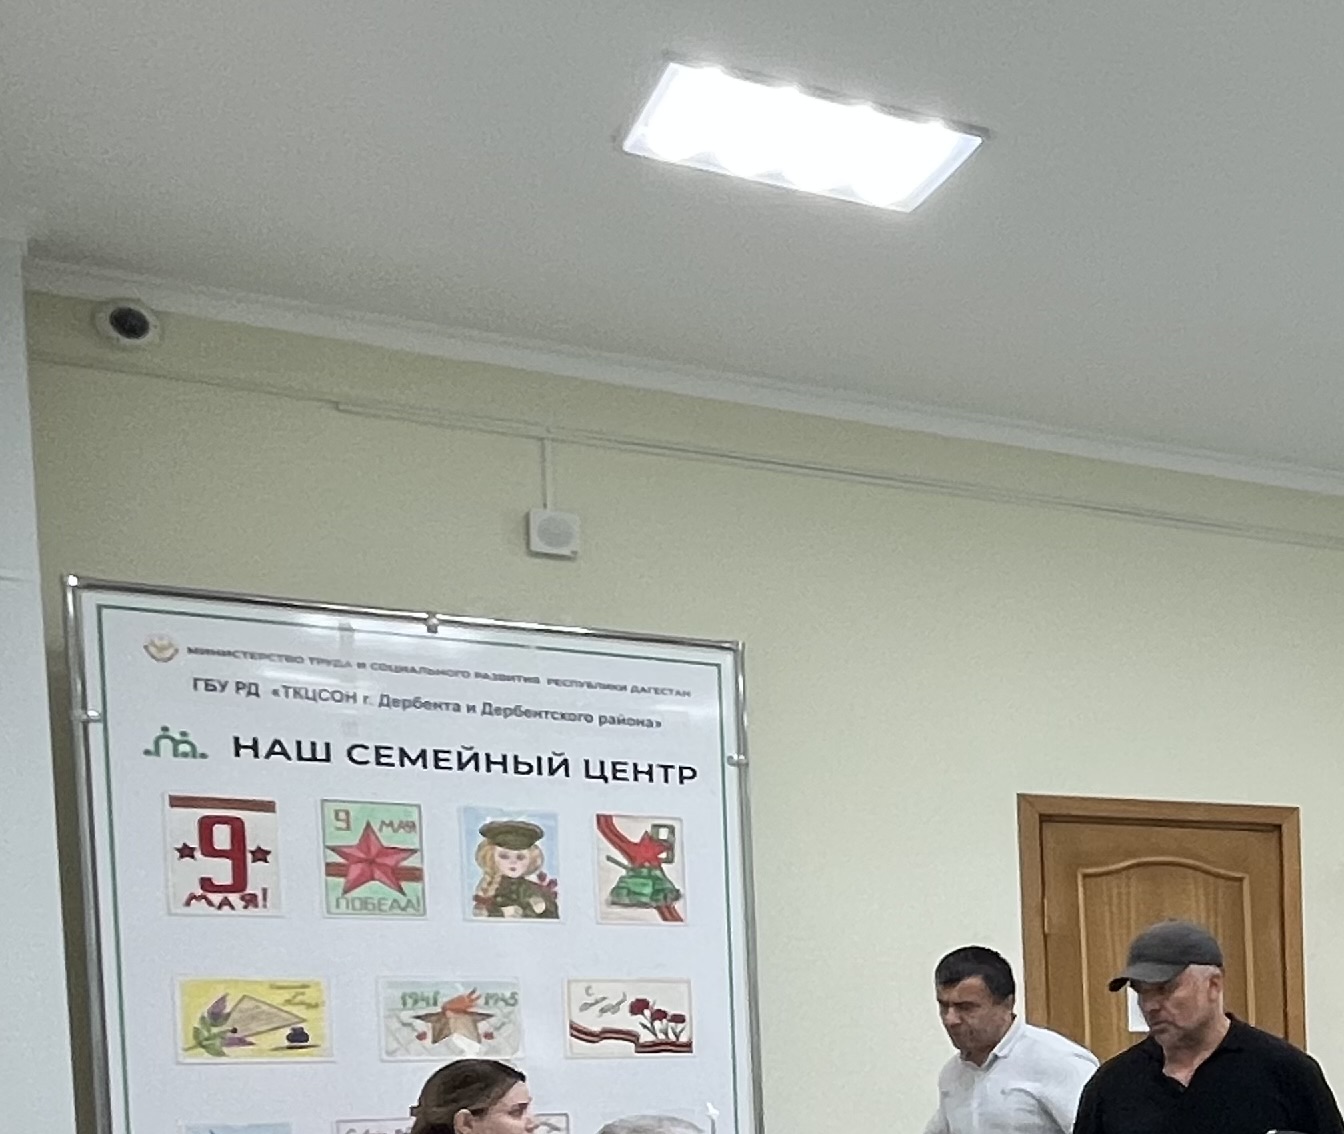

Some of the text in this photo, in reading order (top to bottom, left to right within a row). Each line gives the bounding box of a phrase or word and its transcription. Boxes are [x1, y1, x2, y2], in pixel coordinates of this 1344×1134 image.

[370, 662, 471, 679] СОЦИАЛЬНОГО
[630, 685, 691, 698] ДАГЕСТАН
[193, 677, 229, 693] ГБУ
[235, 680, 260, 698] РД
[272, 684, 357, 704] «ТКЦСОН
[378, 694, 461, 711] Дербента
[466, 703, 476, 713] и
[481, 702, 594, 723] Дербентского
[598, 713, 662, 728] района»
[233, 736, 698, 785] НАШ СЕМЕЙНЫЙ ЦЕНТР
[334, 809, 352, 831] 9
[197, 815, 248, 893] 9
[184, 887, 268, 910] МАЯ!
